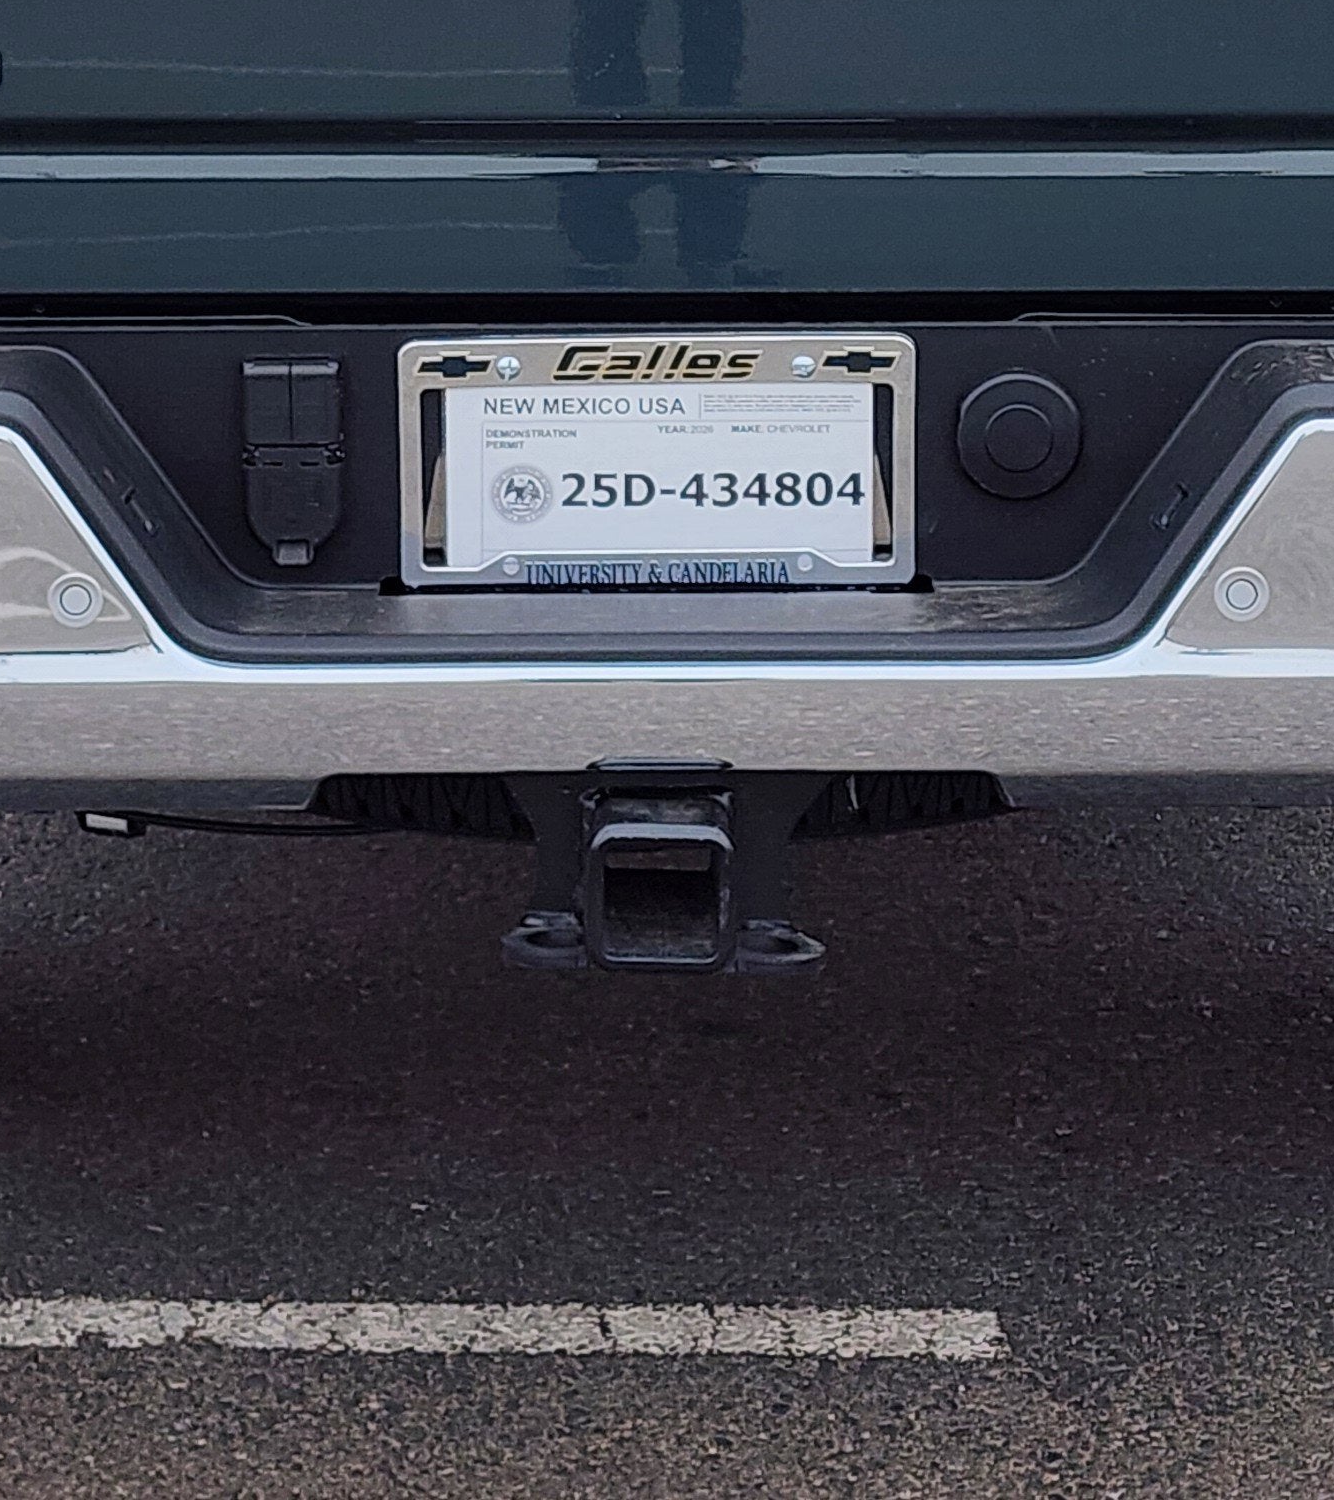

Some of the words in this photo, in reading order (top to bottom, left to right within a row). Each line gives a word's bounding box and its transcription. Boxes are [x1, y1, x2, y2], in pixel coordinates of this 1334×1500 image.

[551, 342, 763, 383] Galles
[483, 397, 535, 415] NEW
[542, 397, 631, 415] MEXICO
[638, 396, 686, 415] USA
[485, 428, 578, 439] DEMONSTRATION
[485, 440, 525, 450] PERMIT
[560, 471, 866, 508] 25D-434804
[525, 560, 643, 585] UNIVERSITY
[648, 561, 665, 584] &
[667, 558, 792, 585] CANDELARIA
